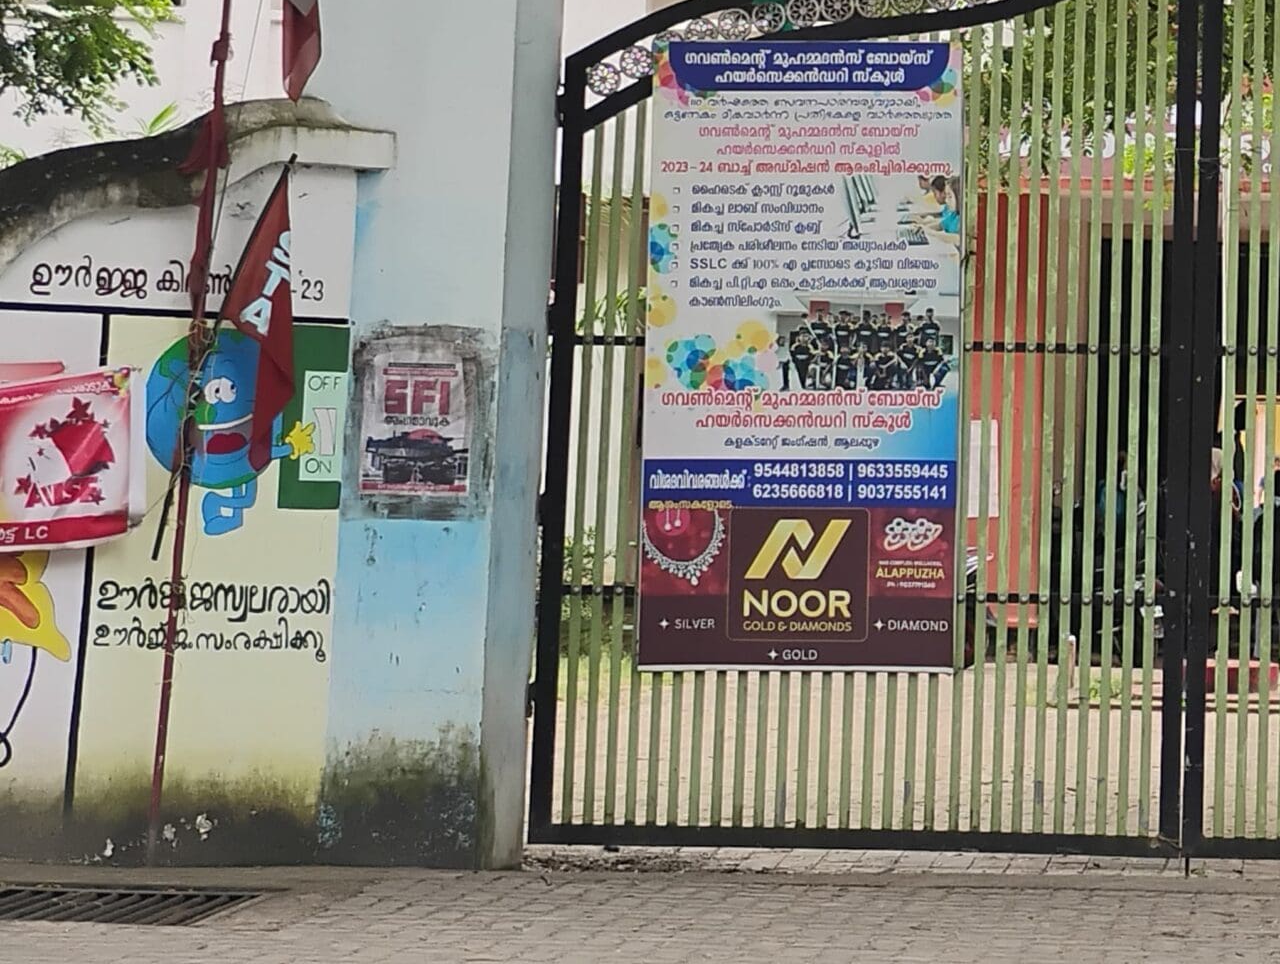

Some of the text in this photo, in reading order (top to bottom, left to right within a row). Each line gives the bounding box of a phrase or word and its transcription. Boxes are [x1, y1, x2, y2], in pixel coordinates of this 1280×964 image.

[690, 258, 727, 269] SSLC
[307, 375, 342, 392] OFF
[384, 379, 451, 416] SFI
[304, 457, 333, 475] ON
[754, 463, 949, 479] 9544813858 9633559445
[752, 484, 948, 500] 6235666818 9037555141
[24, 524, 49, 540] LC
[875, 566, 945, 579] ALAPPUZHA
[743, 589, 852, 618] NOOR
[674, 617, 716, 630] SILVER
[742, 621, 852, 633] GOLD & DIAMONDS
[887, 619, 949, 632] DIAMOND
[782, 649, 818, 661] GOLD
